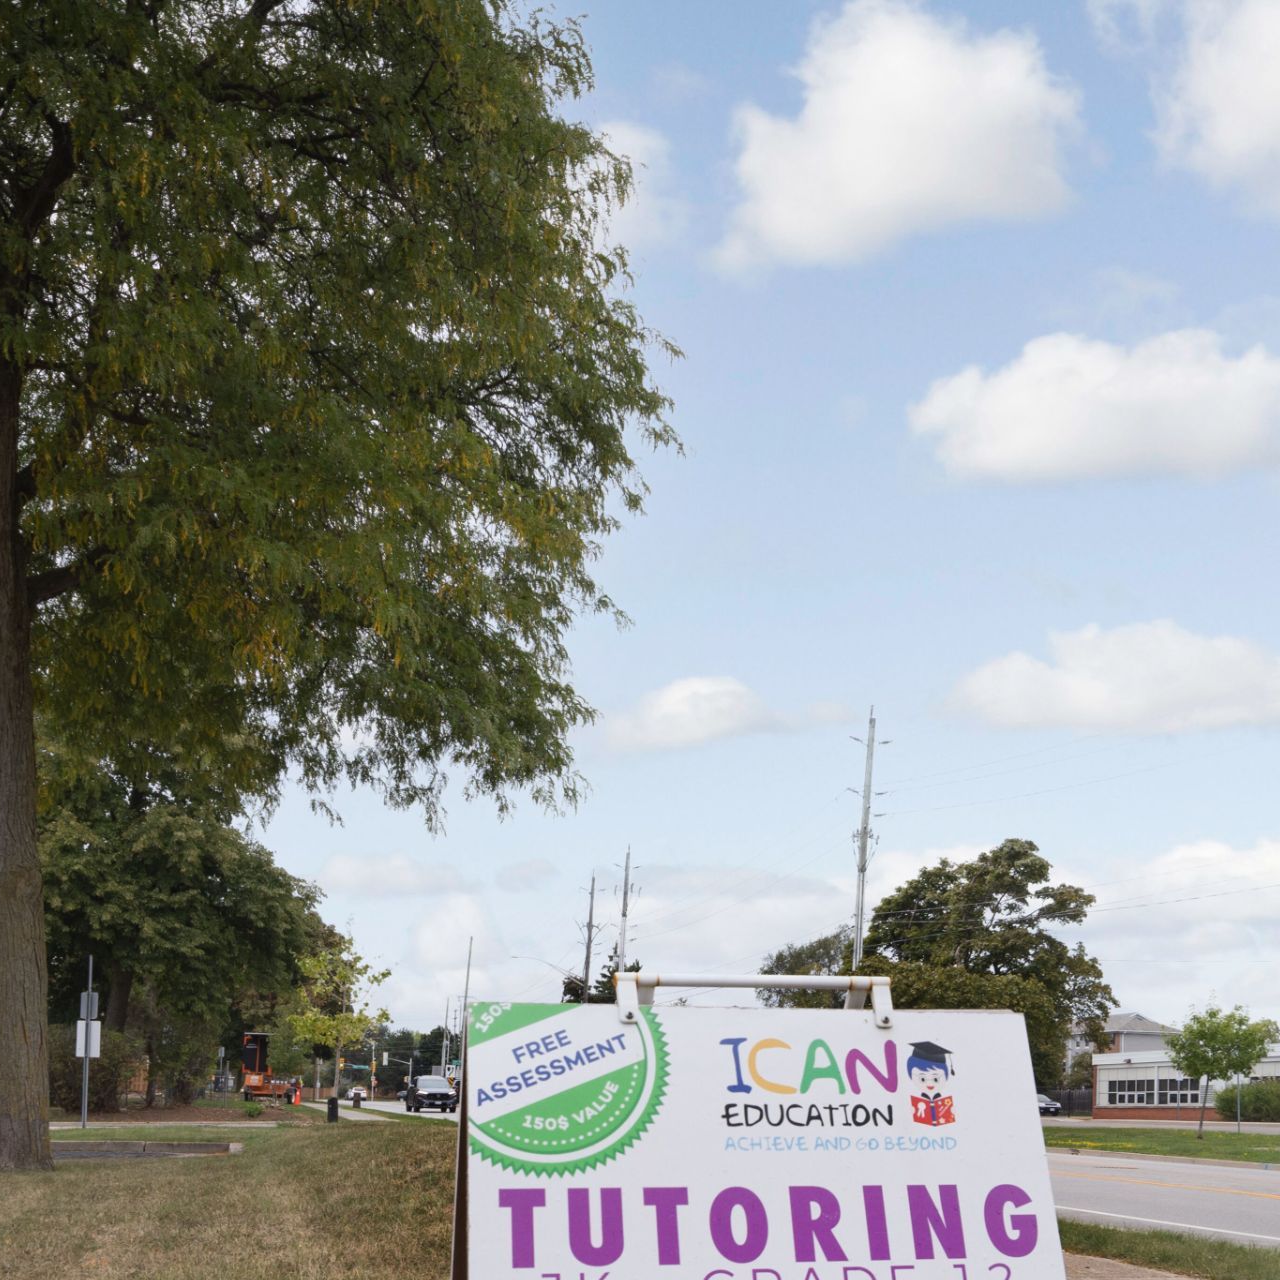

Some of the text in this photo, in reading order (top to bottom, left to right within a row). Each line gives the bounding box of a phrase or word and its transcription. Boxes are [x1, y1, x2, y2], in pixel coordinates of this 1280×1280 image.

[476, 1033, 627, 1106] ASSESSMENT
[512, 1029, 572, 1064] FREE
[720, 1037, 898, 1095] ICAN
[522, 1080, 619, 1131] 150$ VALUE
[721, 1103, 894, 1127] EDUCATION
[724, 1135, 957, 1151] ACHIEVE AND GO BEYOND
[498, 1184, 1038, 1268] TUTORING
